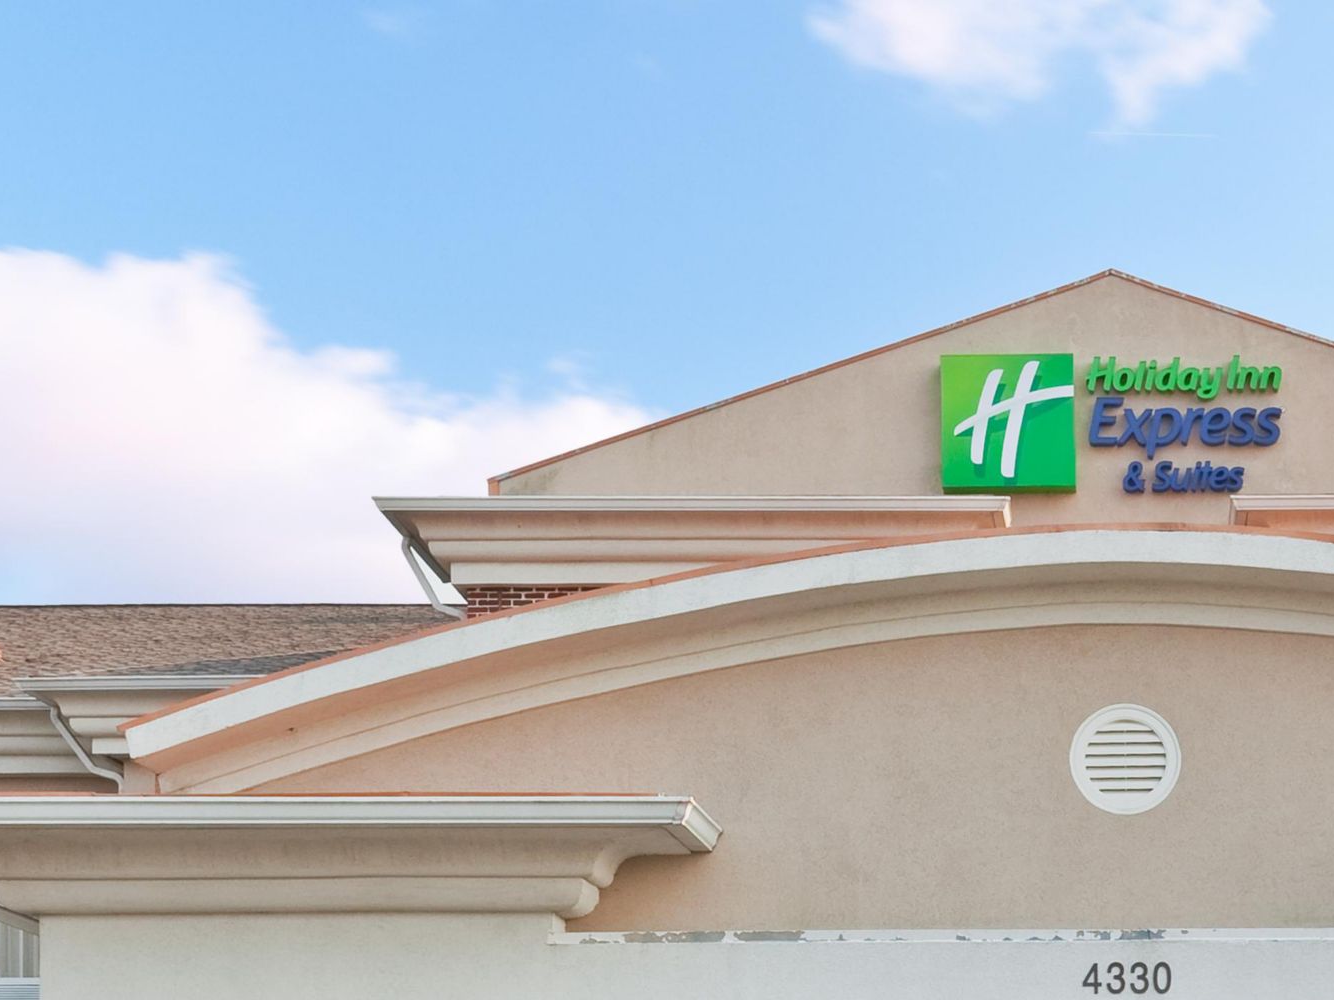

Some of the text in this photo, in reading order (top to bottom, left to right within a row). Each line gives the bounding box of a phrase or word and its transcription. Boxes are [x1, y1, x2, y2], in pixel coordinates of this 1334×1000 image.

[1086, 354, 1283, 399] Holiday Inn
[953, 360, 1075, 478] H
[1088, 396, 1282, 459] Express
[1122, 461, 1245, 493] & Suites
[1082, 961, 1172, 995] 4330
